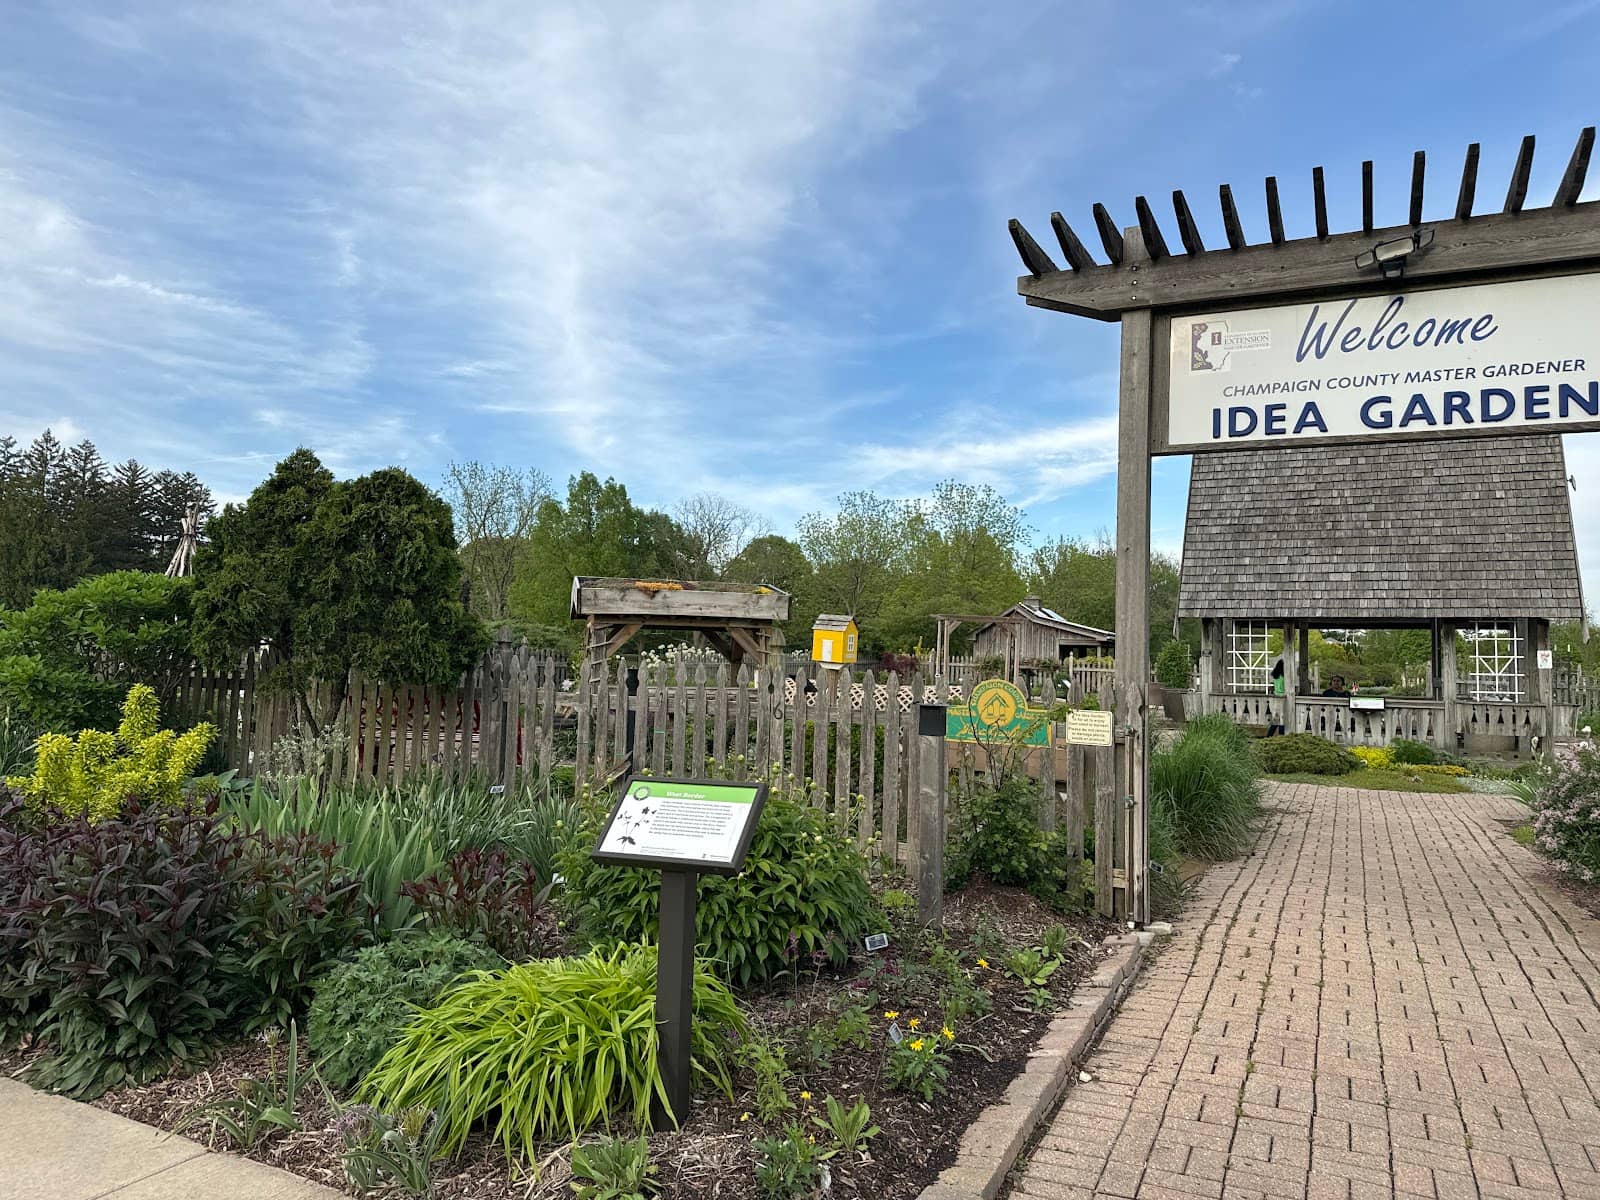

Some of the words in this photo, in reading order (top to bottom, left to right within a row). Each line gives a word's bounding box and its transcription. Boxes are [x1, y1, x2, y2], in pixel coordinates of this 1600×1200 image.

[1296, 295, 1499, 363] Welcome
[1222, 379, 1321, 397] CHAMPAIGN
[1326, 372, 1401, 390] COUNTY
[1404, 367, 1477, 384] MASTER
[1482, 359, 1586, 378] GARDENER
[1212, 401, 1329, 439] IDEA
[1359, 381, 1600, 430] GARDEN
